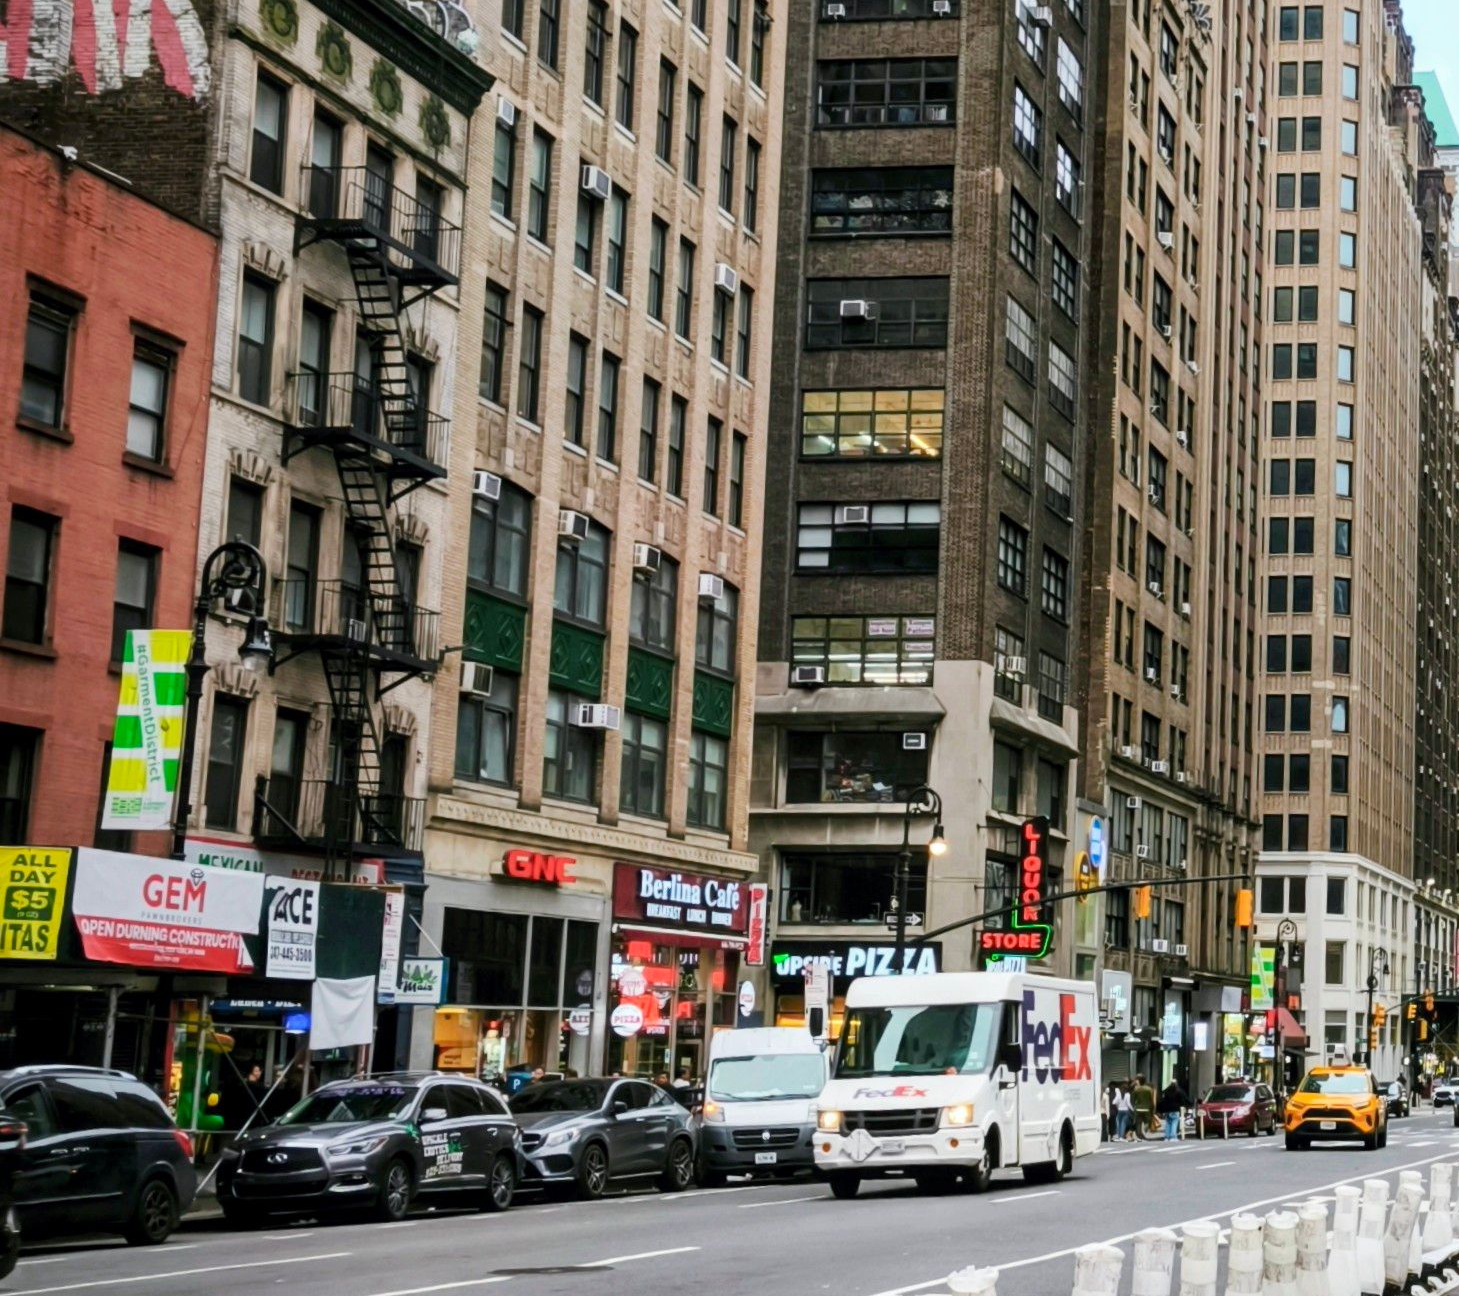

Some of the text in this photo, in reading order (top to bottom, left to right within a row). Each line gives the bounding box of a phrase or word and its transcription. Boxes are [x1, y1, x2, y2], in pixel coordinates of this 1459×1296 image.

[137, 644, 161, 783] #GarmentDistrict
[10, 870, 57, 884] DAY
[13, 854, 57, 868] ALL
[506, 848, 577, 885] GNC
[1023, 823, 1042, 921] LIQUOR
[10, 890, 49, 910] $5
[143, 874, 207, 913] GEM
[273, 886, 314, 925] ACE
[640, 869, 741, 911] Berlina Café
[80, 918, 115, 937] OPEN
[116, 924, 168, 942] DURNING
[982, 932, 1042, 949] STORE
[845, 947, 937, 976] PIZZA
[1021, 990, 1092, 1085] FedEx
[853, 1085, 929, 1099] FedEx
